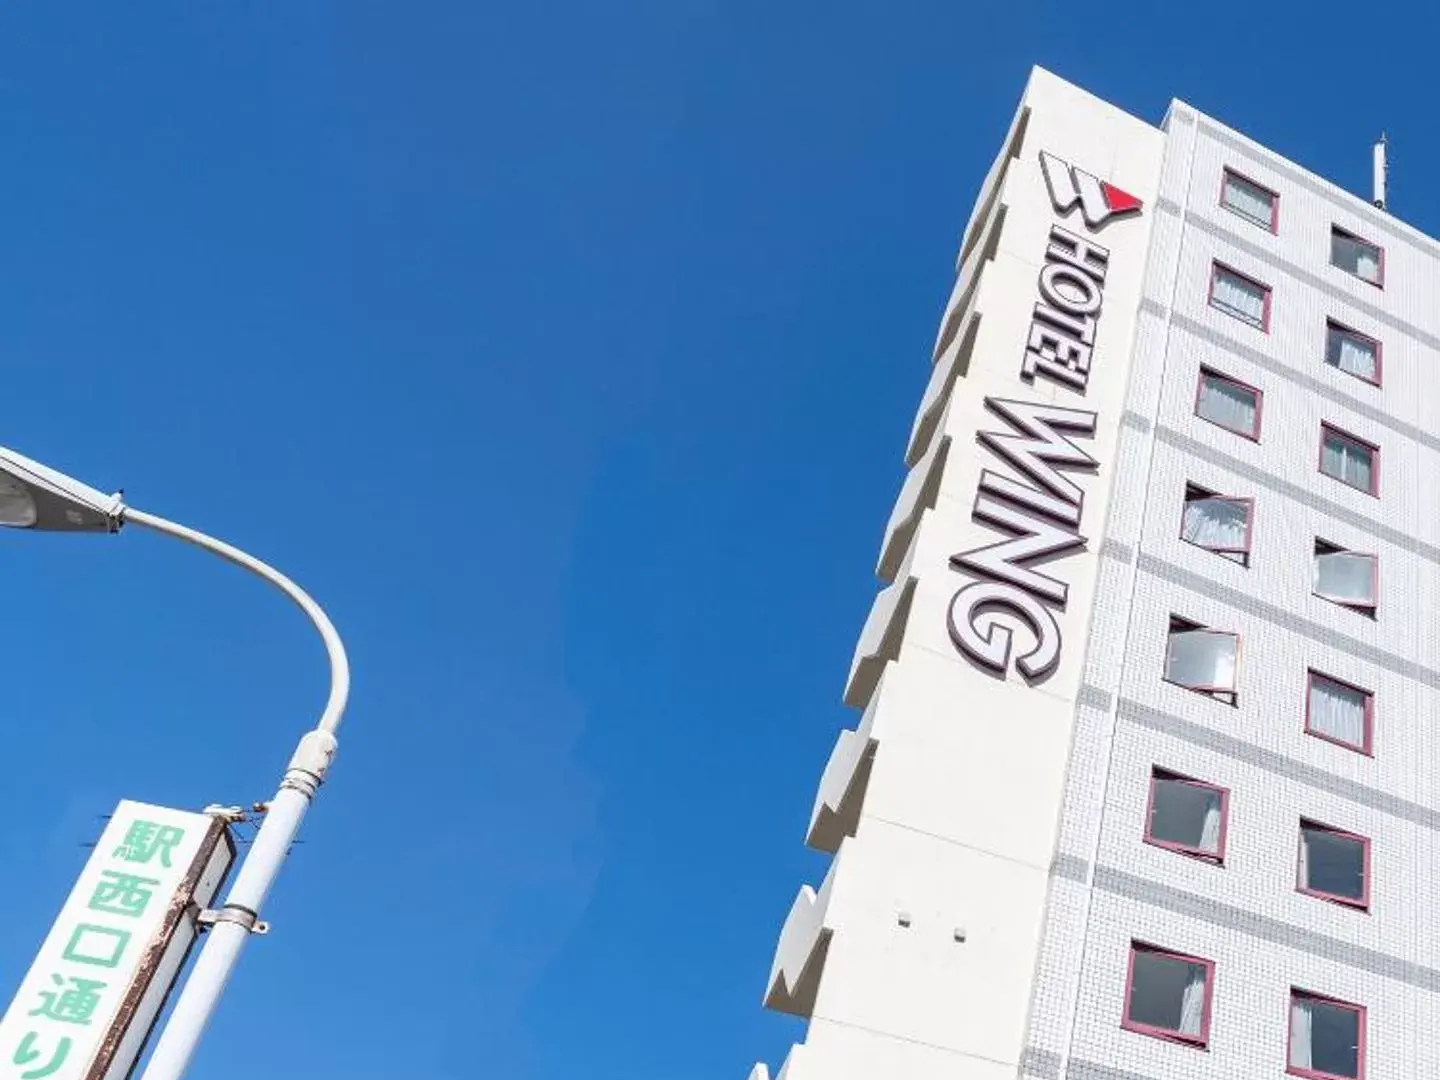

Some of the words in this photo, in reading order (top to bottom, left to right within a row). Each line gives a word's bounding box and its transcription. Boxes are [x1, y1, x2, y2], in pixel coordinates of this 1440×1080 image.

[1021, 222, 1111, 396] HOTEL
[945, 394, 1101, 688] WING
[12, 818, 185, 1080] 駅西口通り
